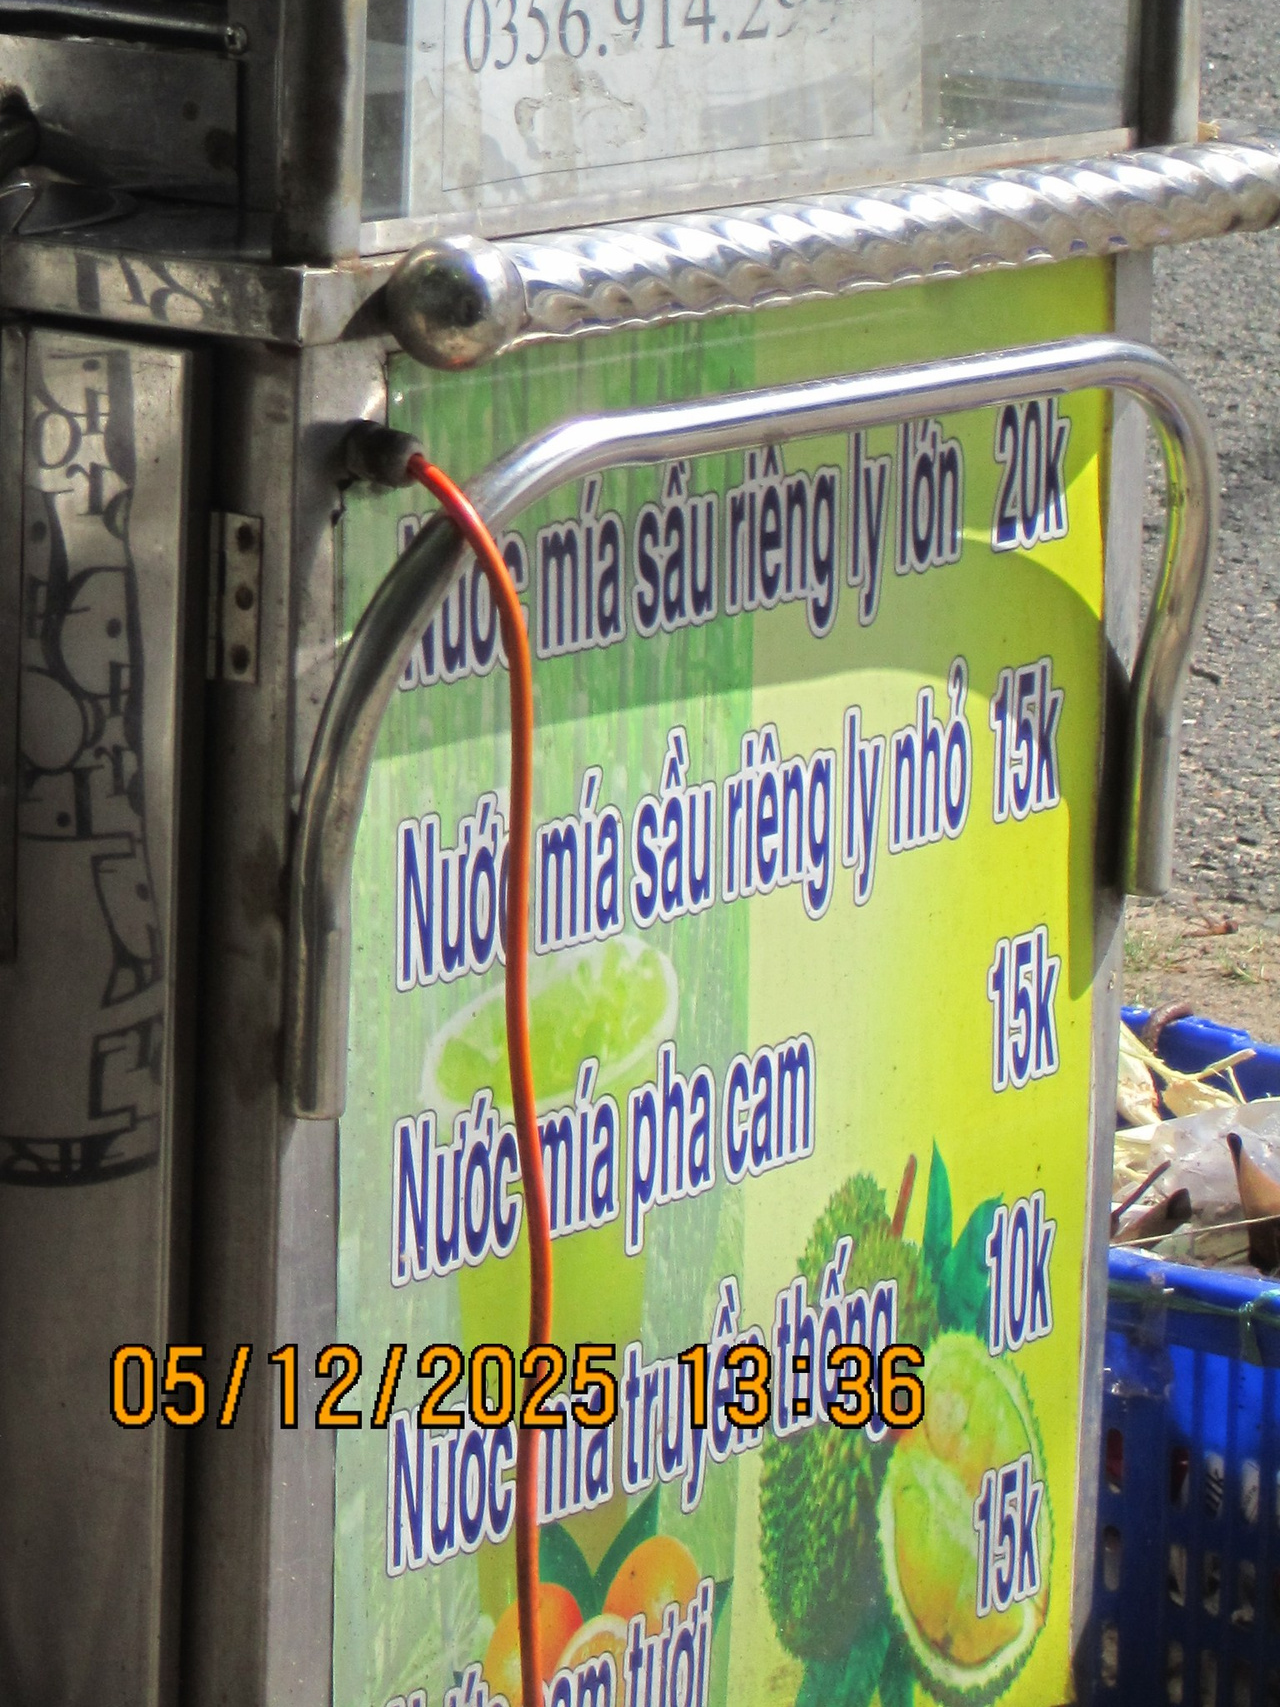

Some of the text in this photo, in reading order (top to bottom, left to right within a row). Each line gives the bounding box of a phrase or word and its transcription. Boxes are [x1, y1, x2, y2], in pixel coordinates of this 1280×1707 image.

[536, 474, 626, 660] mía
[632, 458, 718, 638] sầu
[726, 444, 840, 638] riêng
[847, 433, 892, 627] ly
[895, 420, 964, 576] lớn
[992, 398, 1070, 552] 20k
[535, 765, 623, 955] mía
[631, 726, 717, 930] sầu
[722, 723, 836, 921] riêng
[842, 705, 885, 905] ly
[889, 656, 971, 856] nhỏ
[989, 656, 1063, 824] 15k
[391, 924, 1061, 1287] Nước mía pha cam 15k
[986, 1191, 1058, 1356] 10k
[974, 1455, 1045, 1619] 15k
